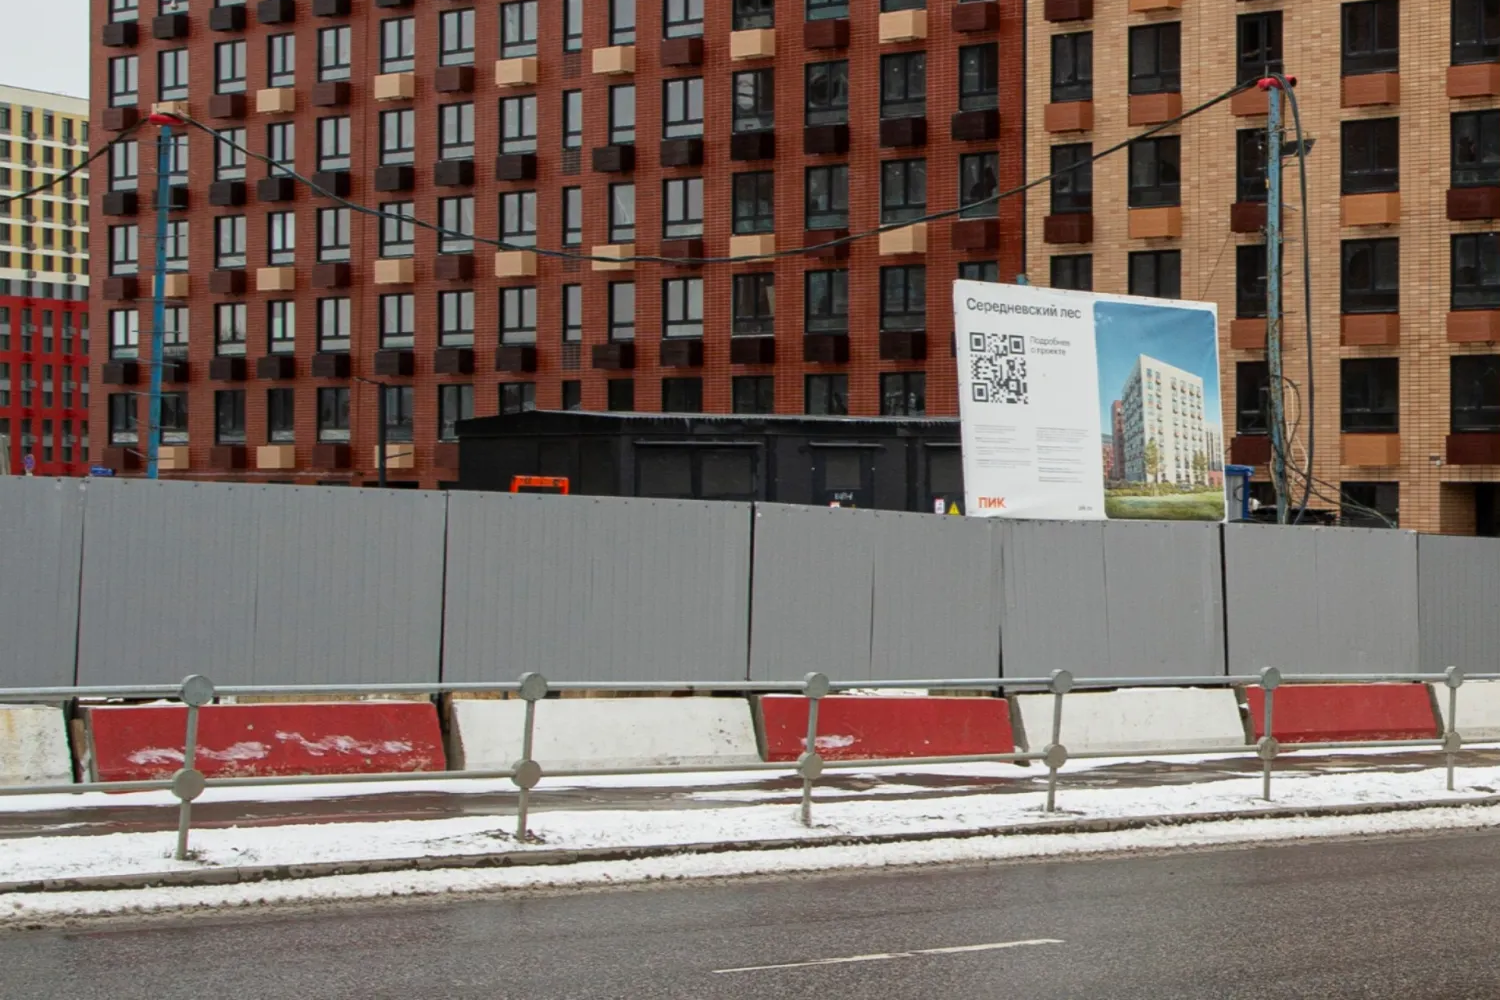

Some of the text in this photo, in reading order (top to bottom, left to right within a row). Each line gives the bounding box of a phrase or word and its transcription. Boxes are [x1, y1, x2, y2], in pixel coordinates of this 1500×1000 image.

[966, 297, 1082, 319] Середневский лес
[978, 496, 1007, 509] ПИК
